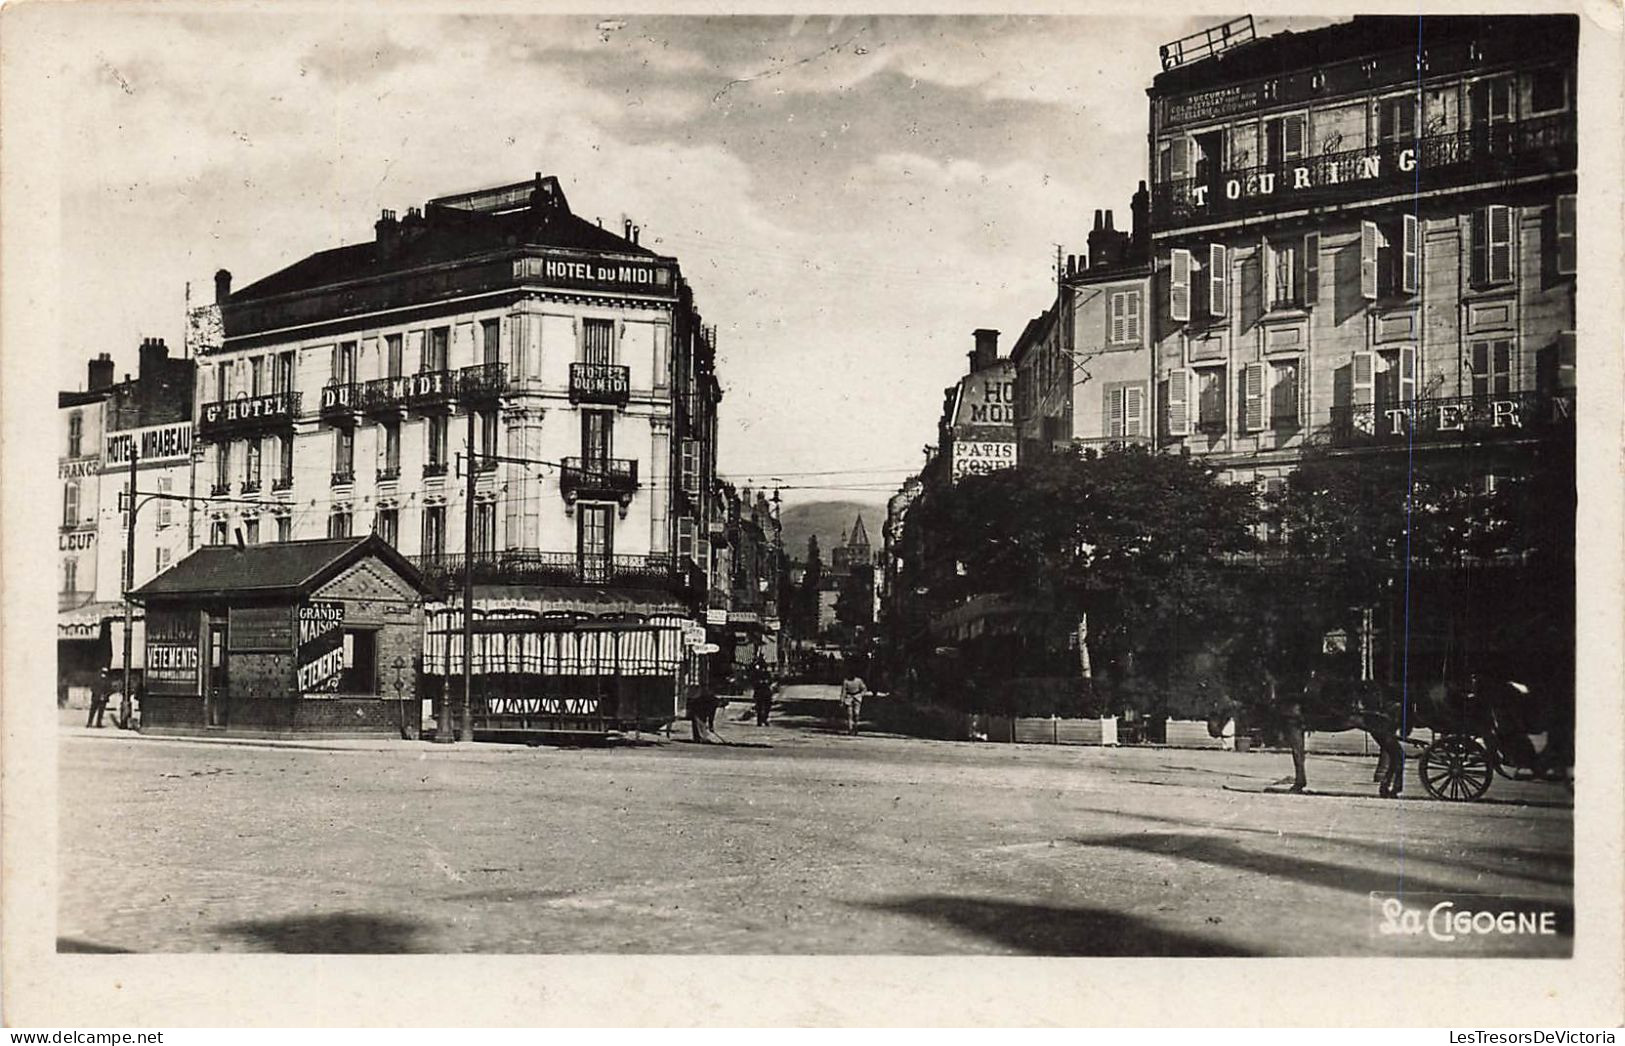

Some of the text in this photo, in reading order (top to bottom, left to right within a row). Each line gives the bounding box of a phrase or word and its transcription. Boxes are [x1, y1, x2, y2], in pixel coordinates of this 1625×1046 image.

[1192, 149, 1417, 206] TOURING
[546, 261, 654, 284] HOTEL DU MIDI
[597, 379, 628, 392] MIDI
[227, 397, 287, 421] HOTEL
[325, 389, 349, 408] DU
[392, 374, 443, 400] MIDI
[106, 427, 191, 463] HOTEL MIRABEAU
[955, 443, 1013, 458] PATIS
[58, 460, 99, 479] FRANCE
[299, 607, 343, 621] GRANDE
[299, 620, 339, 646] MAISON
